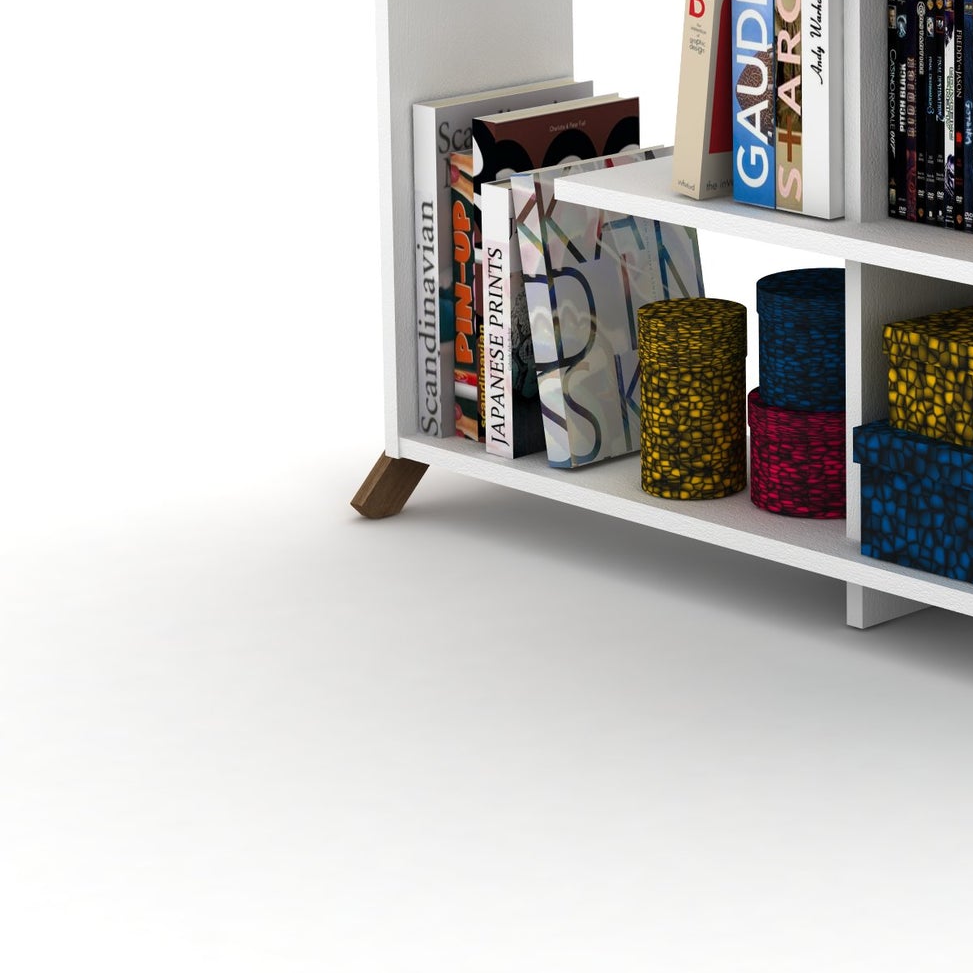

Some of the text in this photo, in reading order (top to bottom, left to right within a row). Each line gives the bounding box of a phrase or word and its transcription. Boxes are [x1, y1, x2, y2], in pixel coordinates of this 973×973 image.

[810, 46, 825, 85] Andy
[416, 200, 439, 436] Scandinavian
[453, 200, 474, 364] PIN-UP
[487, 247, 510, 446] JAPANESE PRINTS
